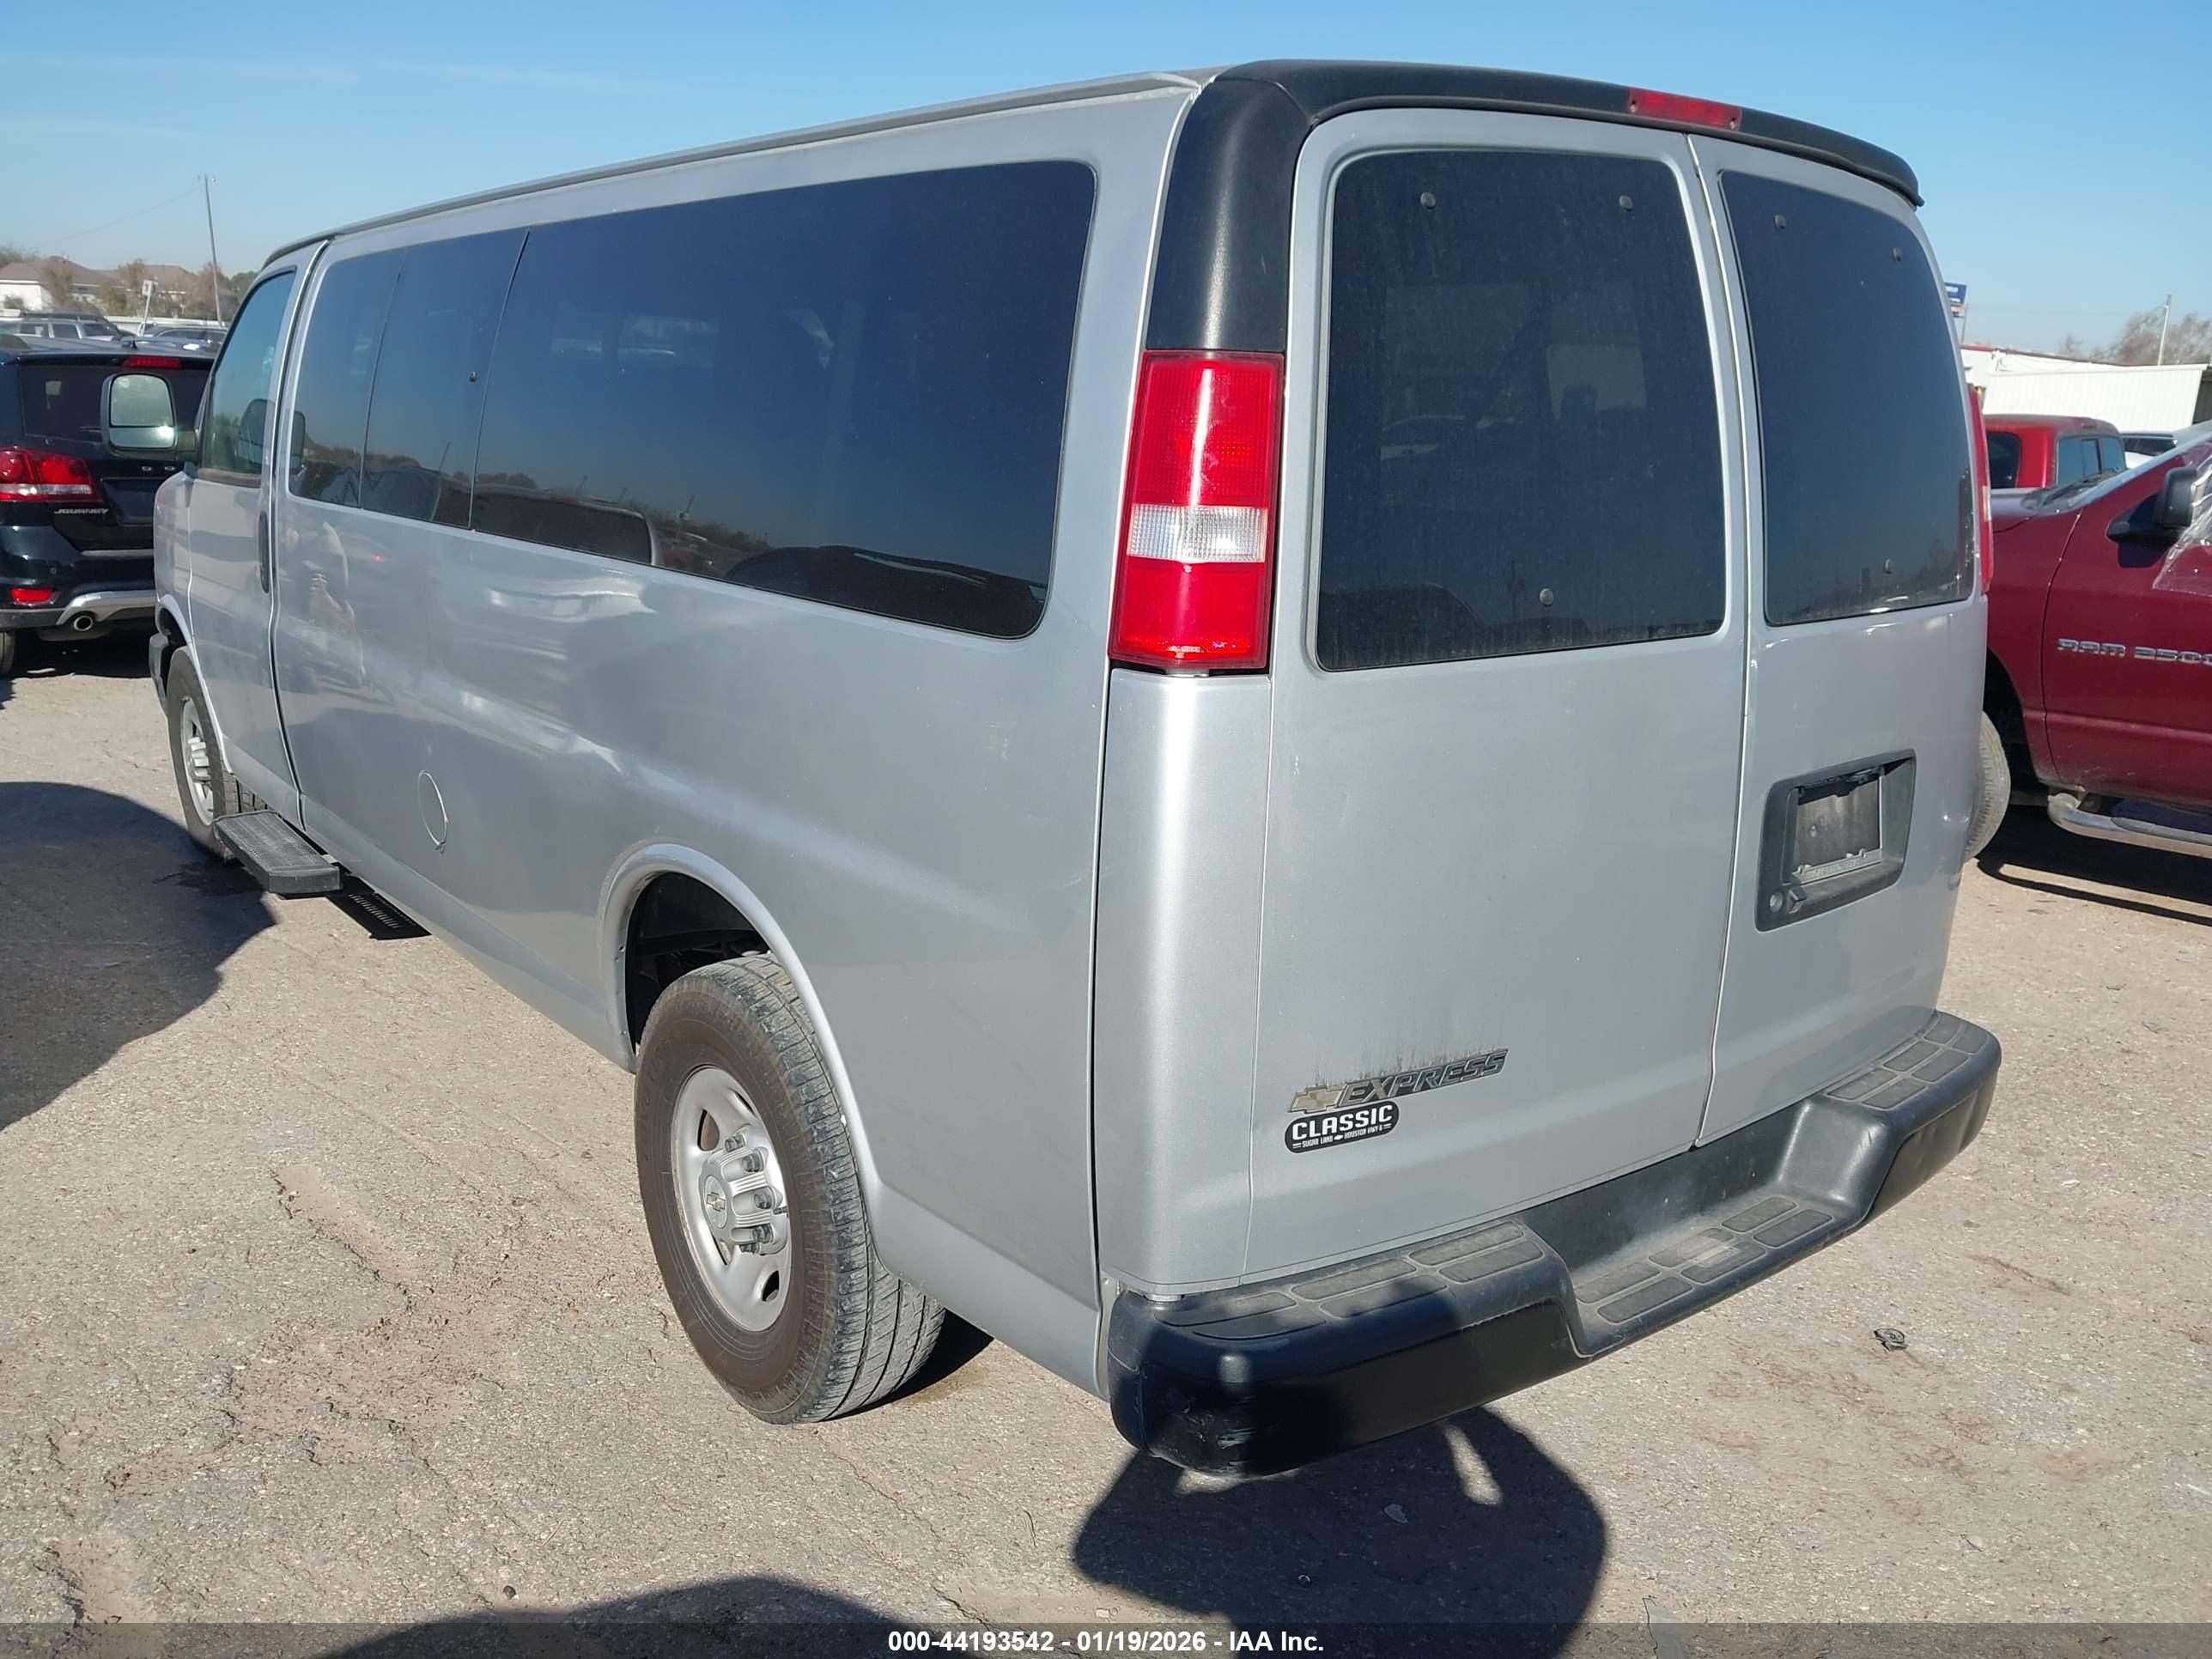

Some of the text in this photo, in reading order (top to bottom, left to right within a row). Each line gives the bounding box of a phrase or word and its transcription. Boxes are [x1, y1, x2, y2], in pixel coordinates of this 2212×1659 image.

[2057, 638, 2126, 657] RAM
[1336, 1049, 1510, 1109] EXPRESS
[1292, 1105, 1393, 1141] CLASSIC
[1302, 1139, 1319, 1148] SUGAR
[1321, 1135, 1334, 1145] LAND
[1344, 1129, 1367, 1140] HOUSTON
